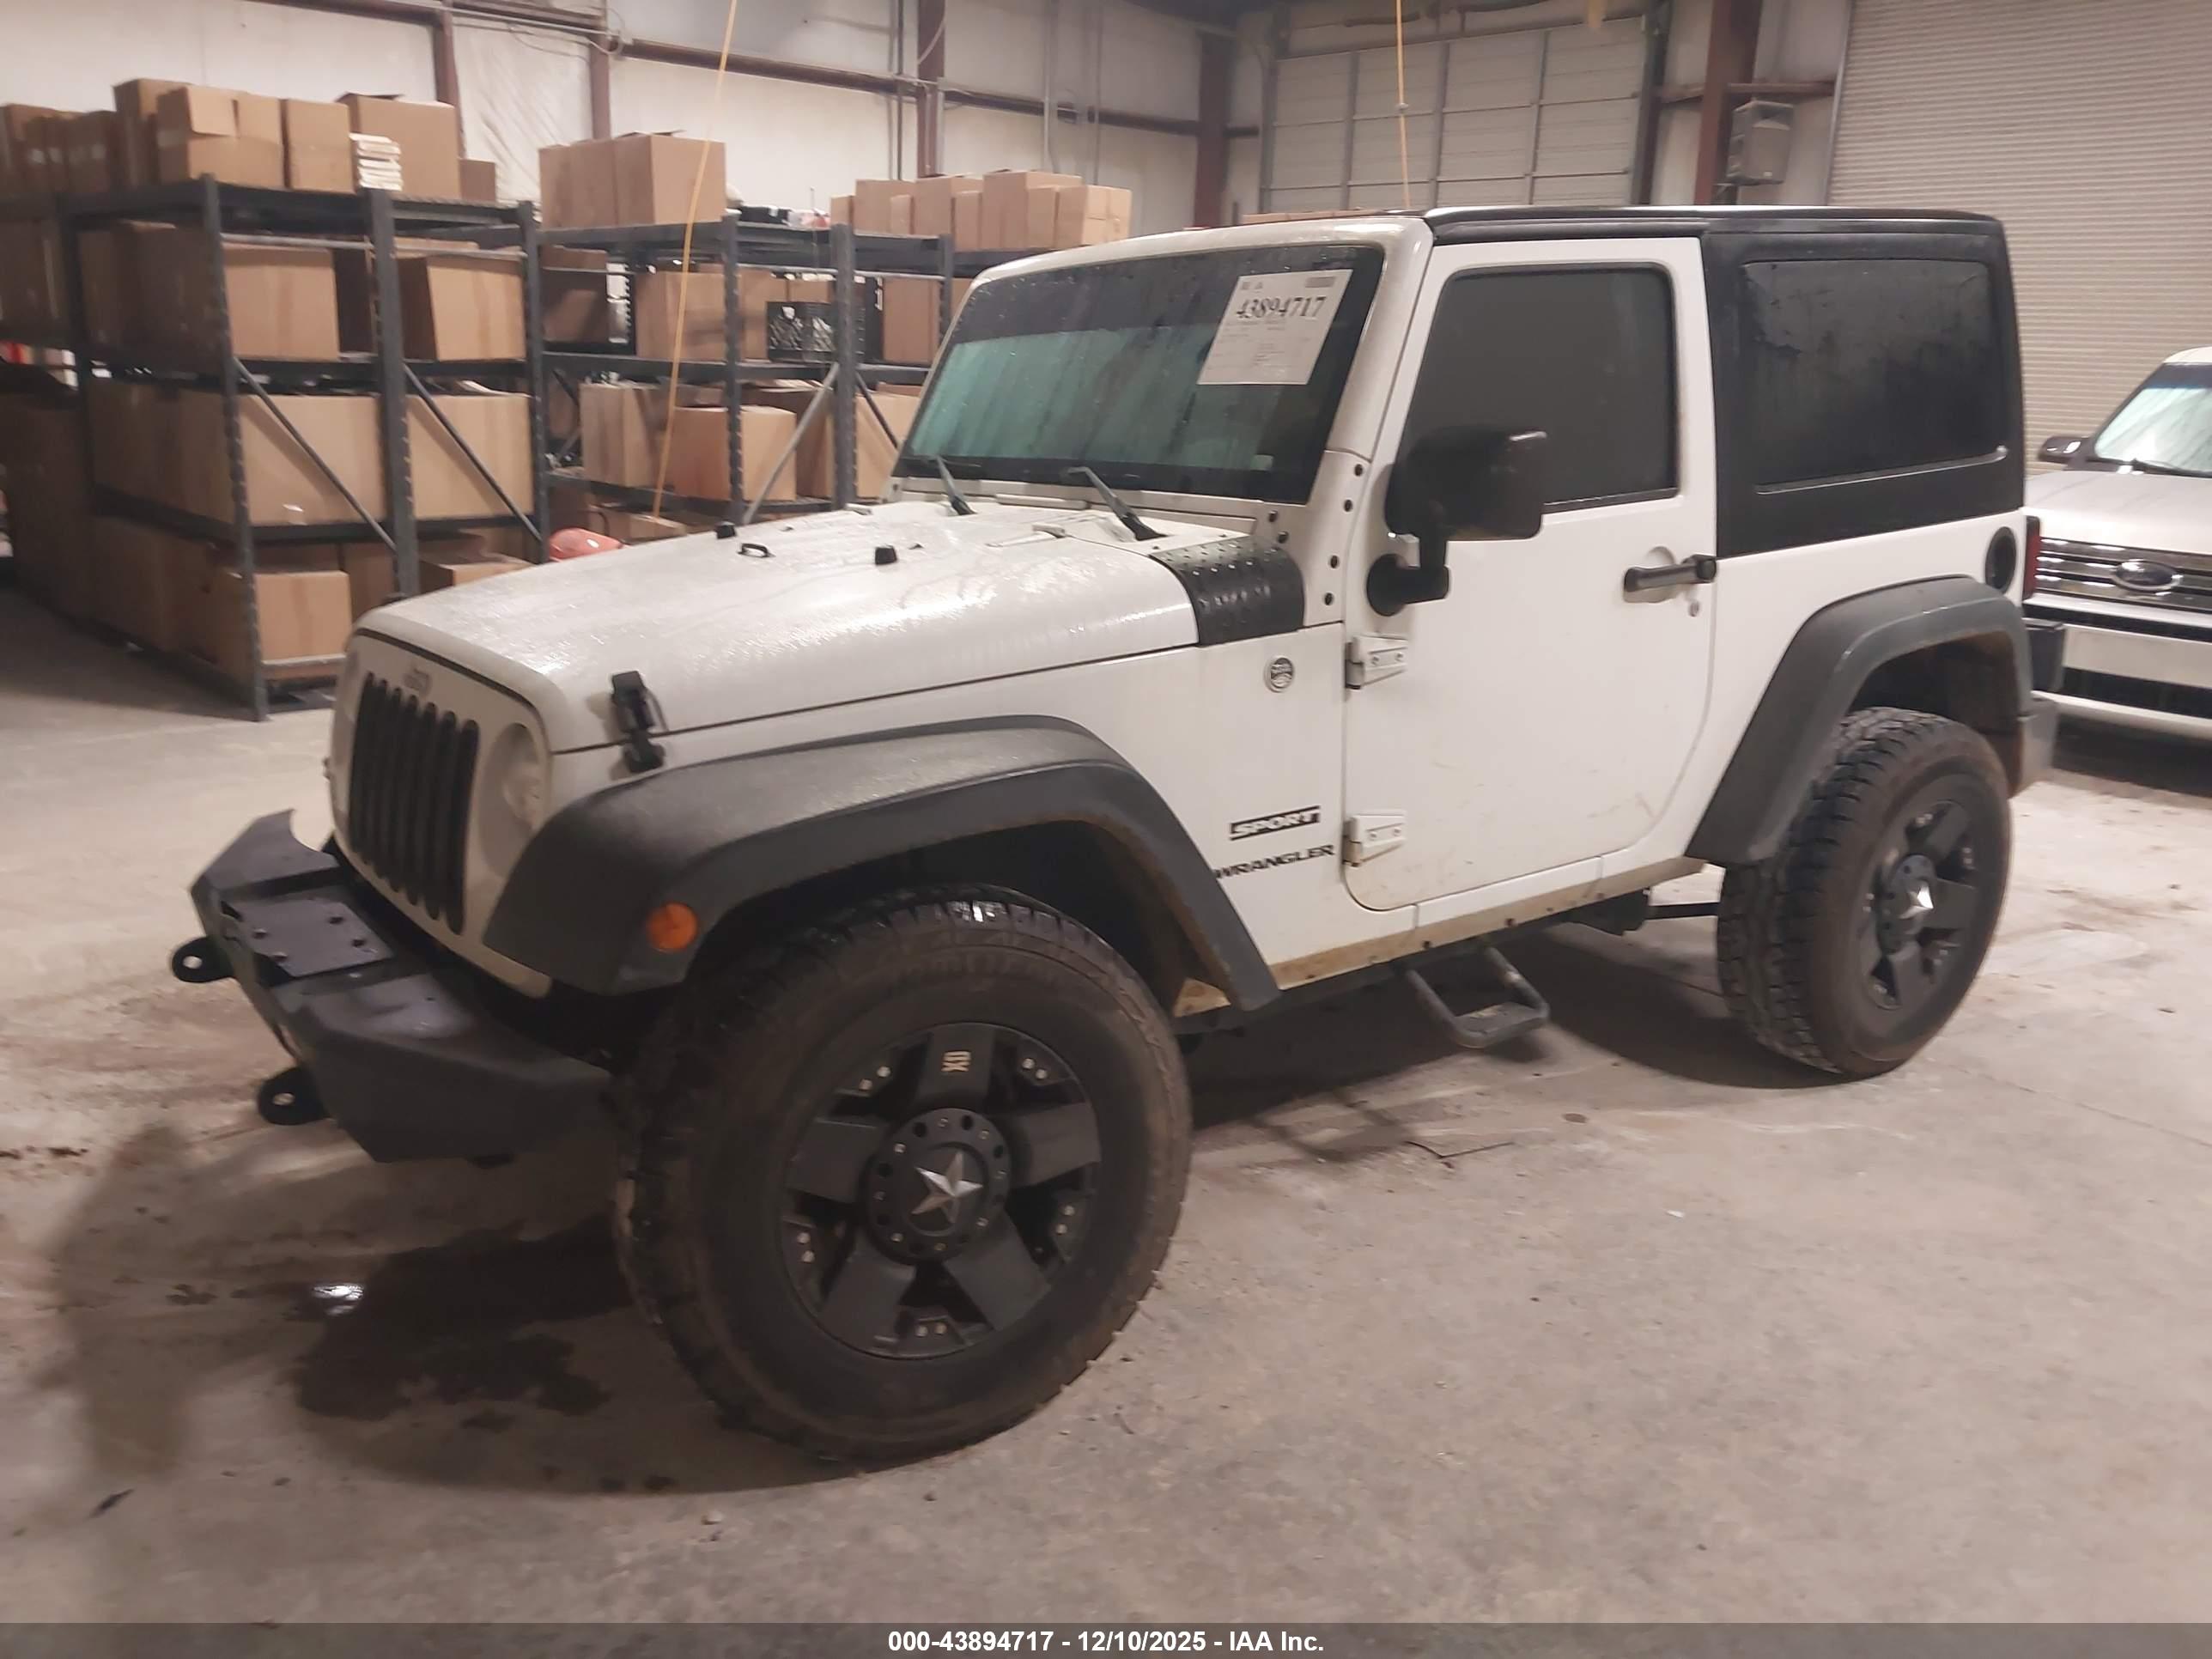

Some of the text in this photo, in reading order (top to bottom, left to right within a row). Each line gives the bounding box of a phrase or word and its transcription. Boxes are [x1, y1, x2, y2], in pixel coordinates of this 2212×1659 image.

[1236, 296, 1328, 319] 43894717
[1231, 805, 1321, 841] SPORT
[1213, 844, 1335, 878] WRANGLER
